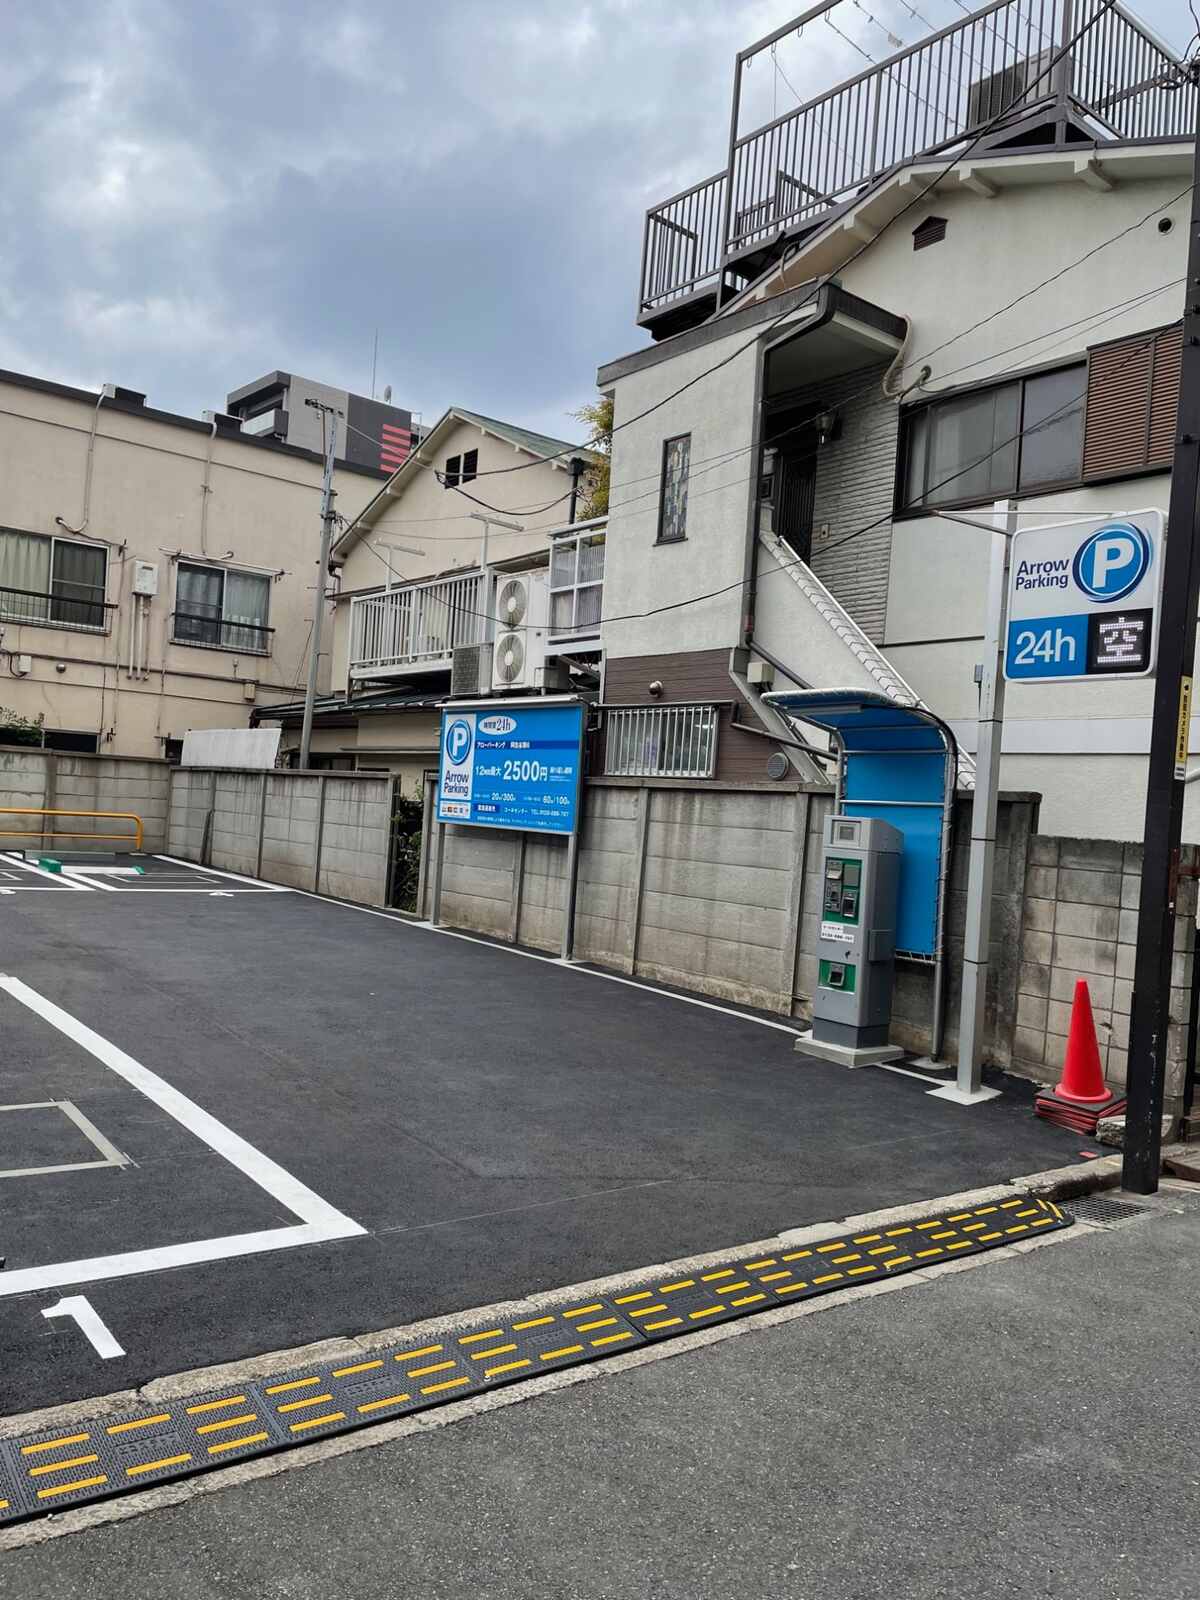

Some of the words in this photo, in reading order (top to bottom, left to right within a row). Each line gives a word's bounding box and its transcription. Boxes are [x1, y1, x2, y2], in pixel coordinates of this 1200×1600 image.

[1017, 559, 1070, 577] Arrow
[1092, 537, 1135, 589] P
[1015, 574, 1069, 591] Parking
[1014, 628, 1075, 664] 24h
[1097, 617, 1144, 664] 空
[452, 727, 467, 757] P
[445, 770, 469, 784] Arrow
[503, 760, 548, 782] 2500円
[443, 782, 468, 797] Parking
[40, 1294, 127, 1360] 1
